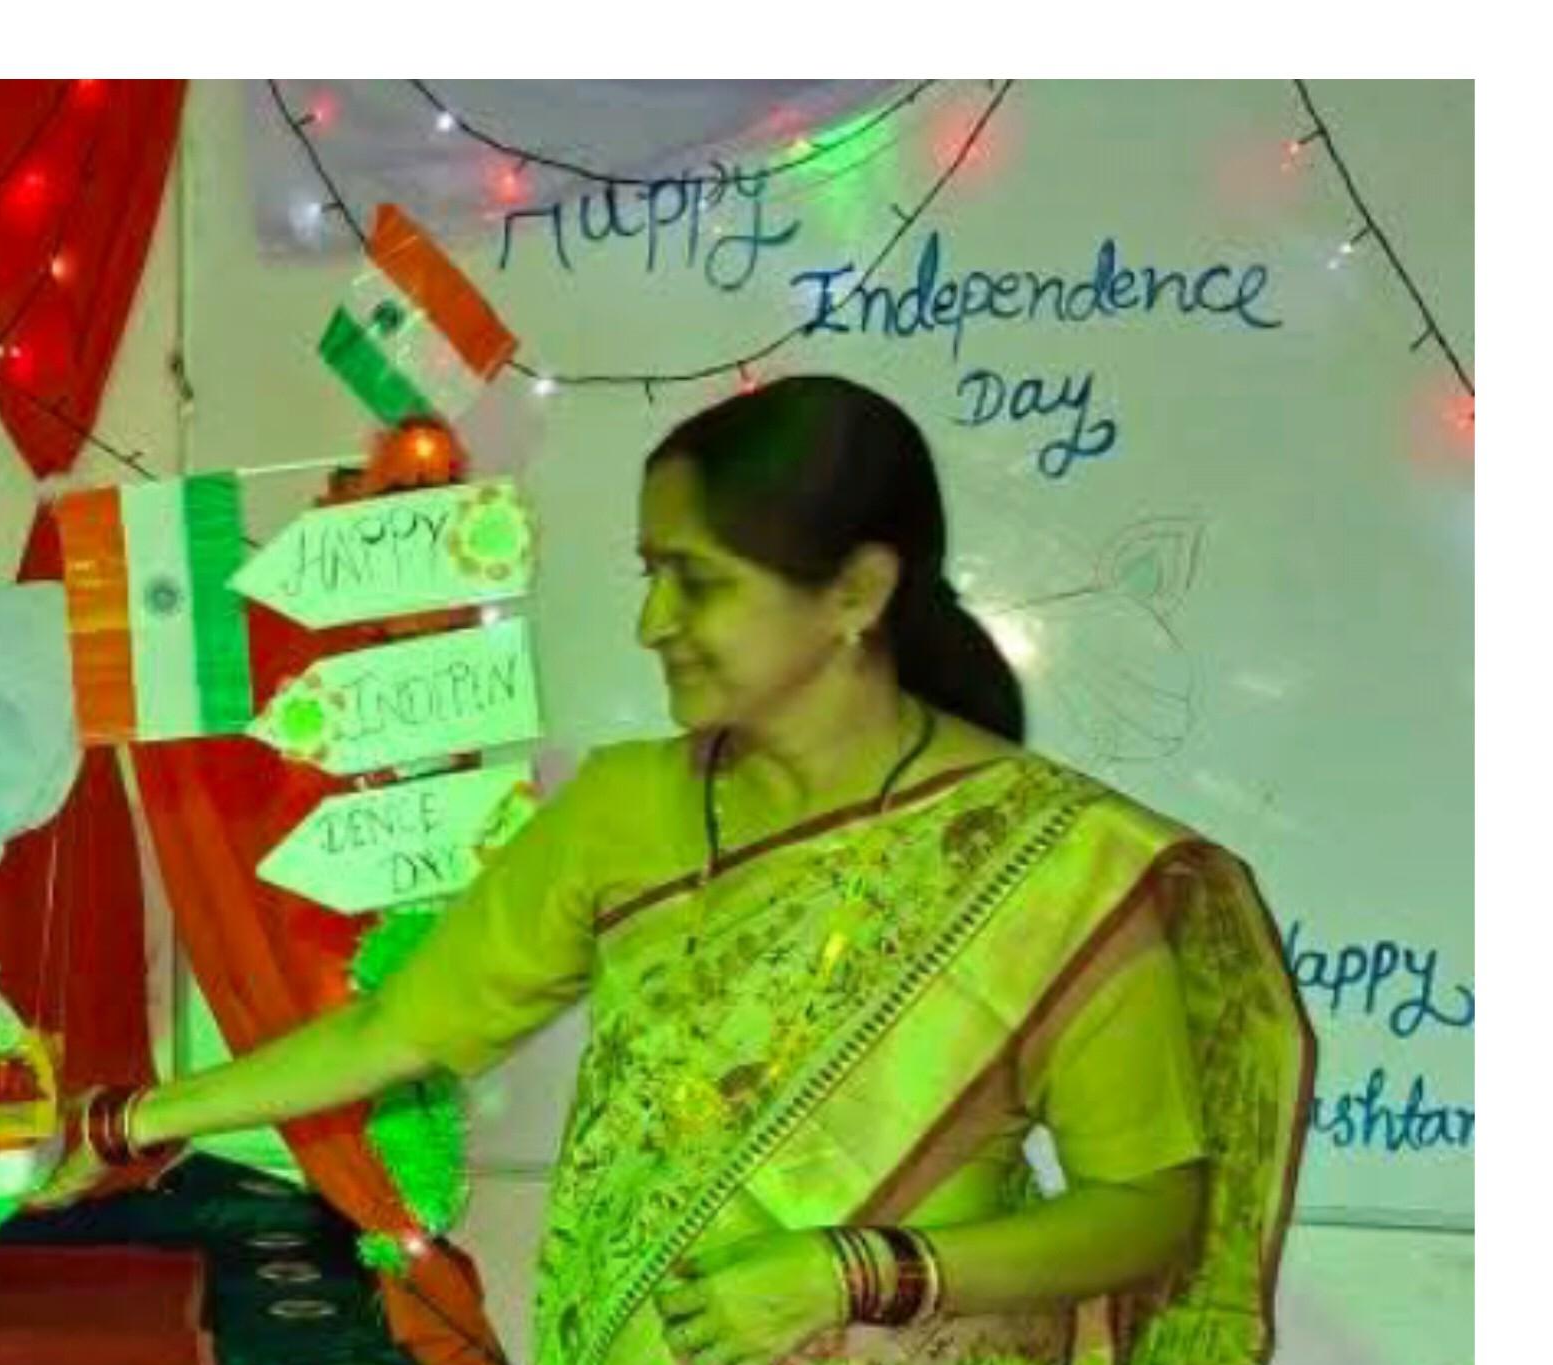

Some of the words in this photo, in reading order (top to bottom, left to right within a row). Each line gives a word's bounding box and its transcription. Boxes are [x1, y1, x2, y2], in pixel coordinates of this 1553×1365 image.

[791, 230, 1283, 357] Independence
[949, 367, 1116, 479] Day
[282, 510, 449, 597] HAPPY
